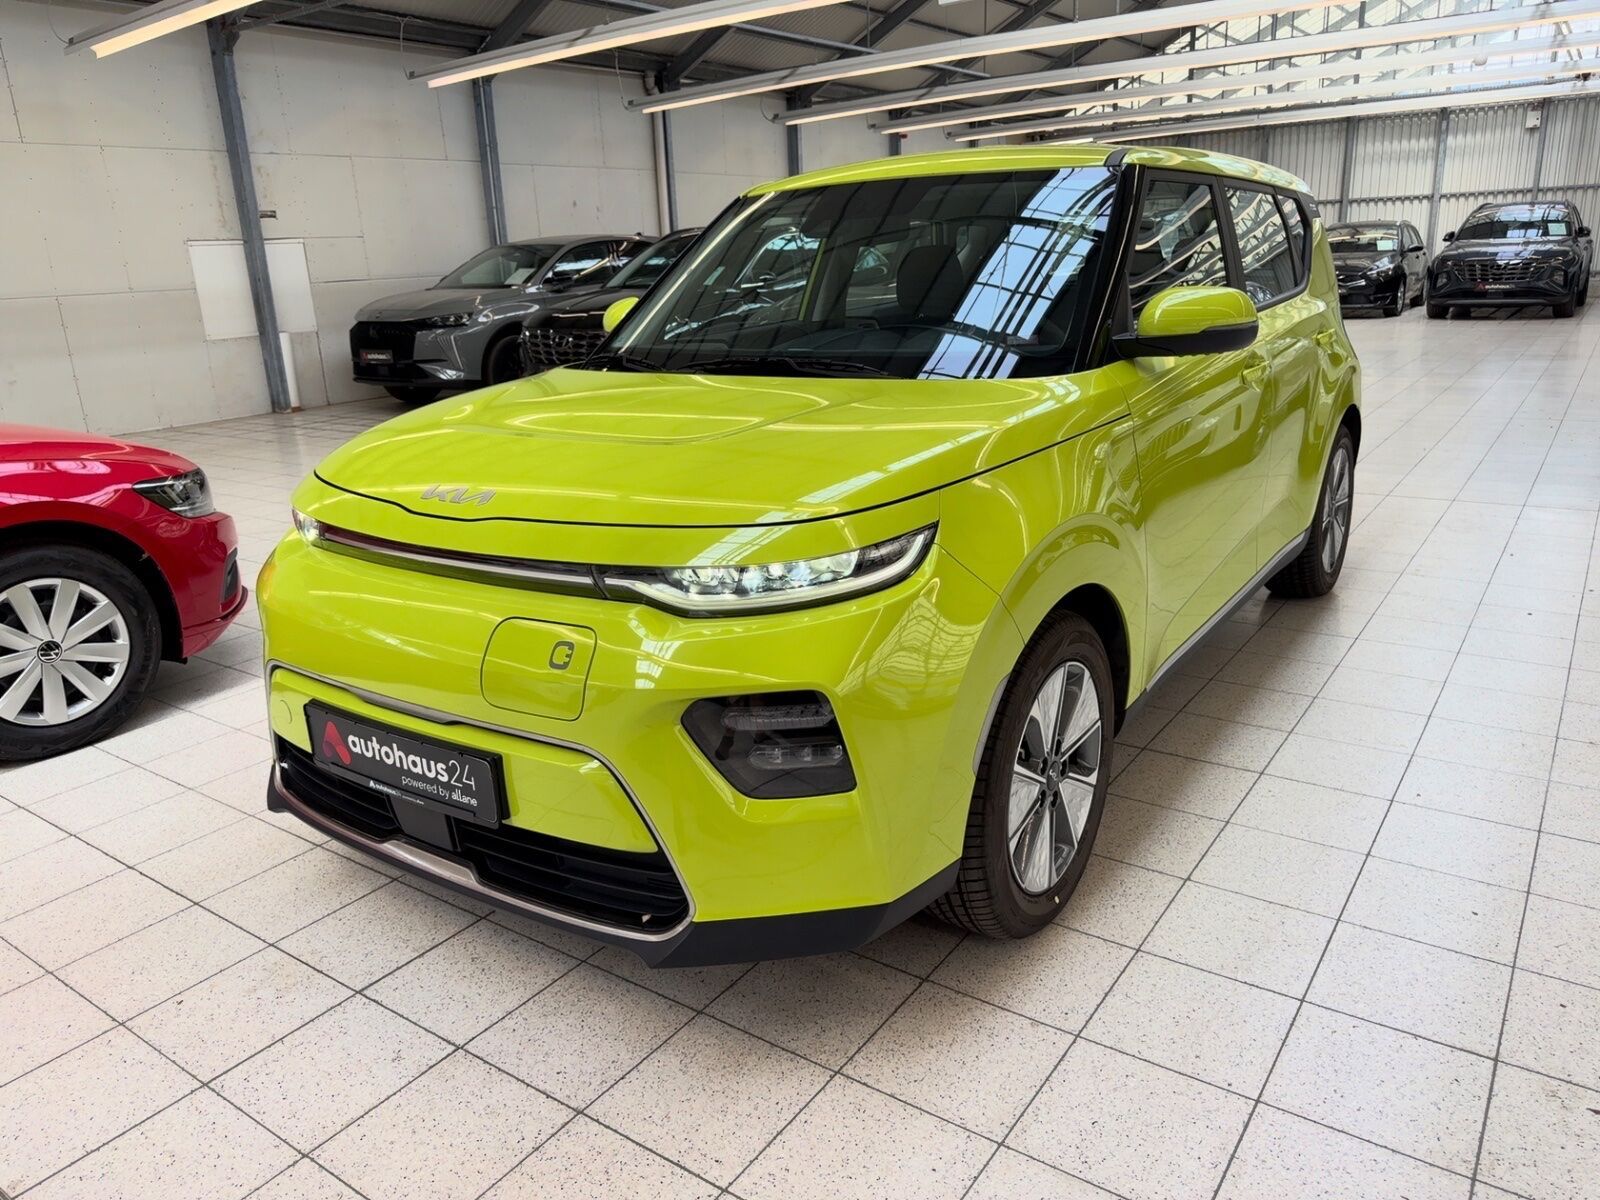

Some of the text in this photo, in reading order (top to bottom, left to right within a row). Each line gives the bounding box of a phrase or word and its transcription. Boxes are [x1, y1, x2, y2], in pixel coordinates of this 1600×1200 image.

[347, 734, 476, 791] autohaus24
[401, 775, 478, 807] powered by allane
